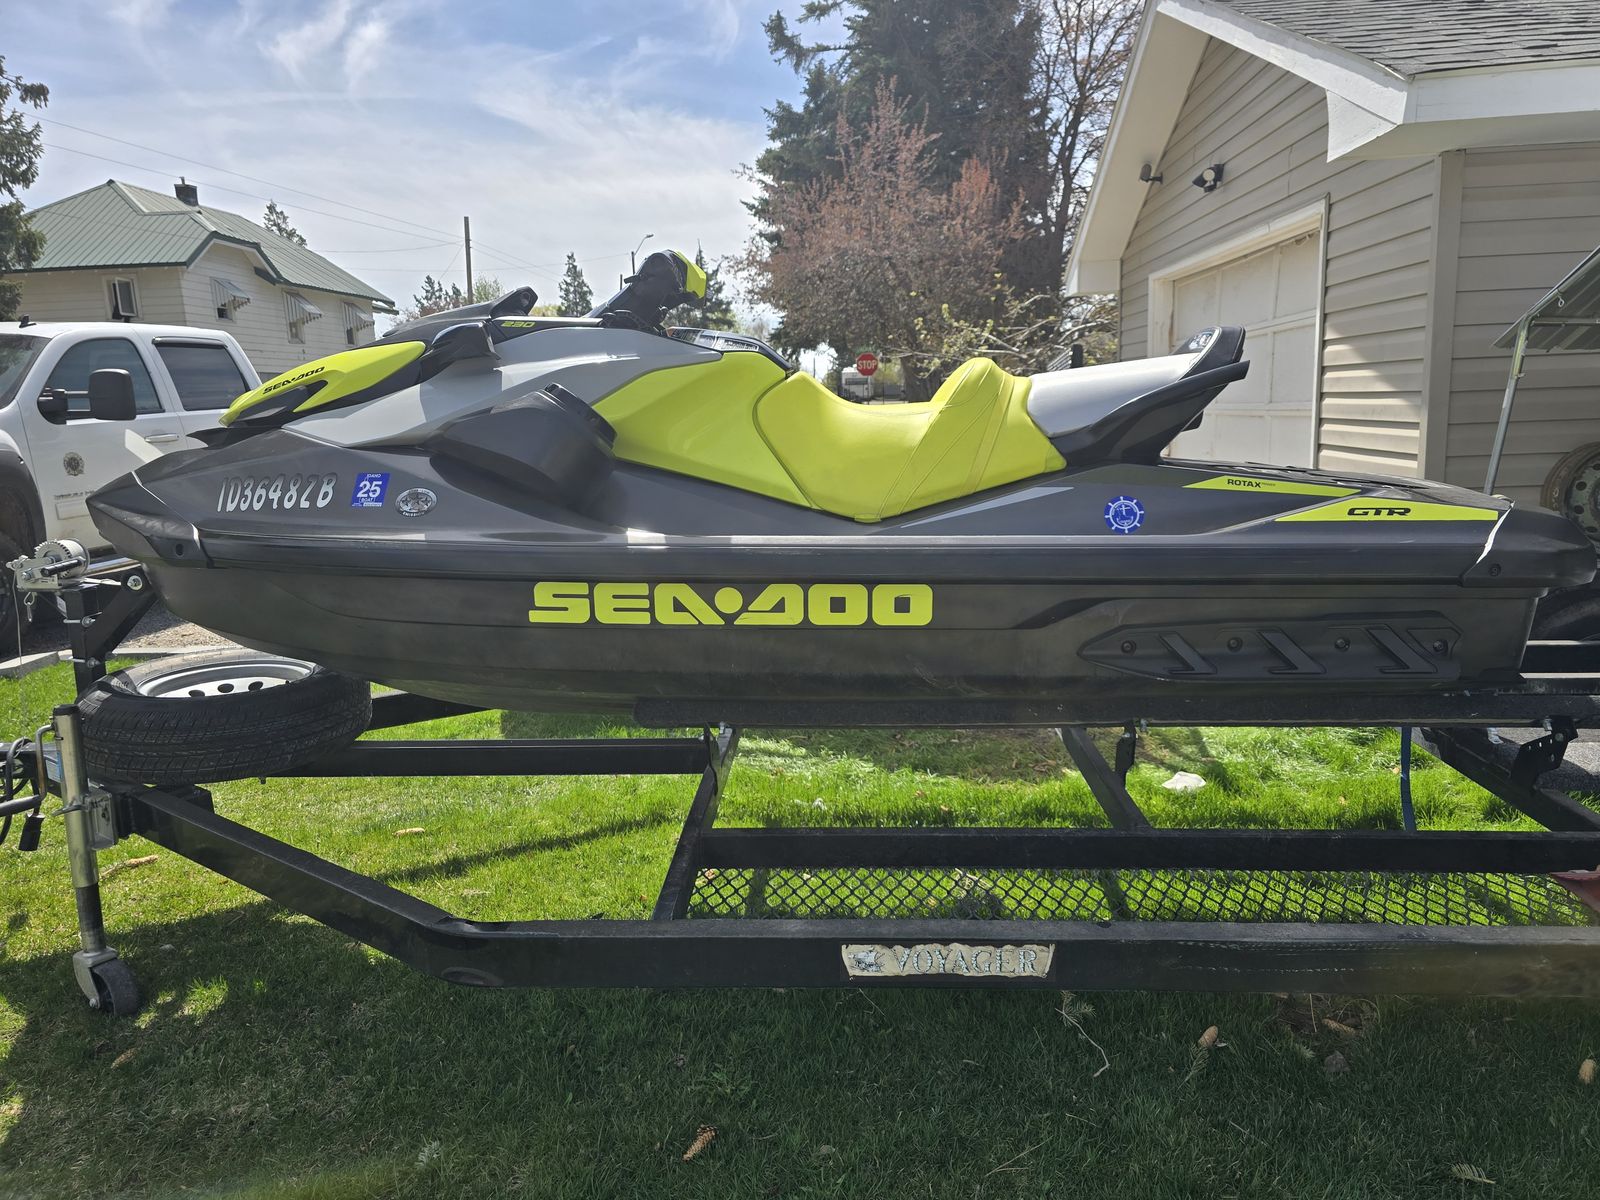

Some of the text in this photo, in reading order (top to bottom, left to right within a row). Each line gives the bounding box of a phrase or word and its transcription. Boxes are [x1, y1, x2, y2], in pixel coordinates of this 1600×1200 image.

[858, 360, 877, 370] STOP
[1227, 478, 1262, 488] ROTAX
[356, 480, 382, 498] 25
[1347, 507, 1412, 517] GTR
[893, 949, 1039, 974] VOYAGER
